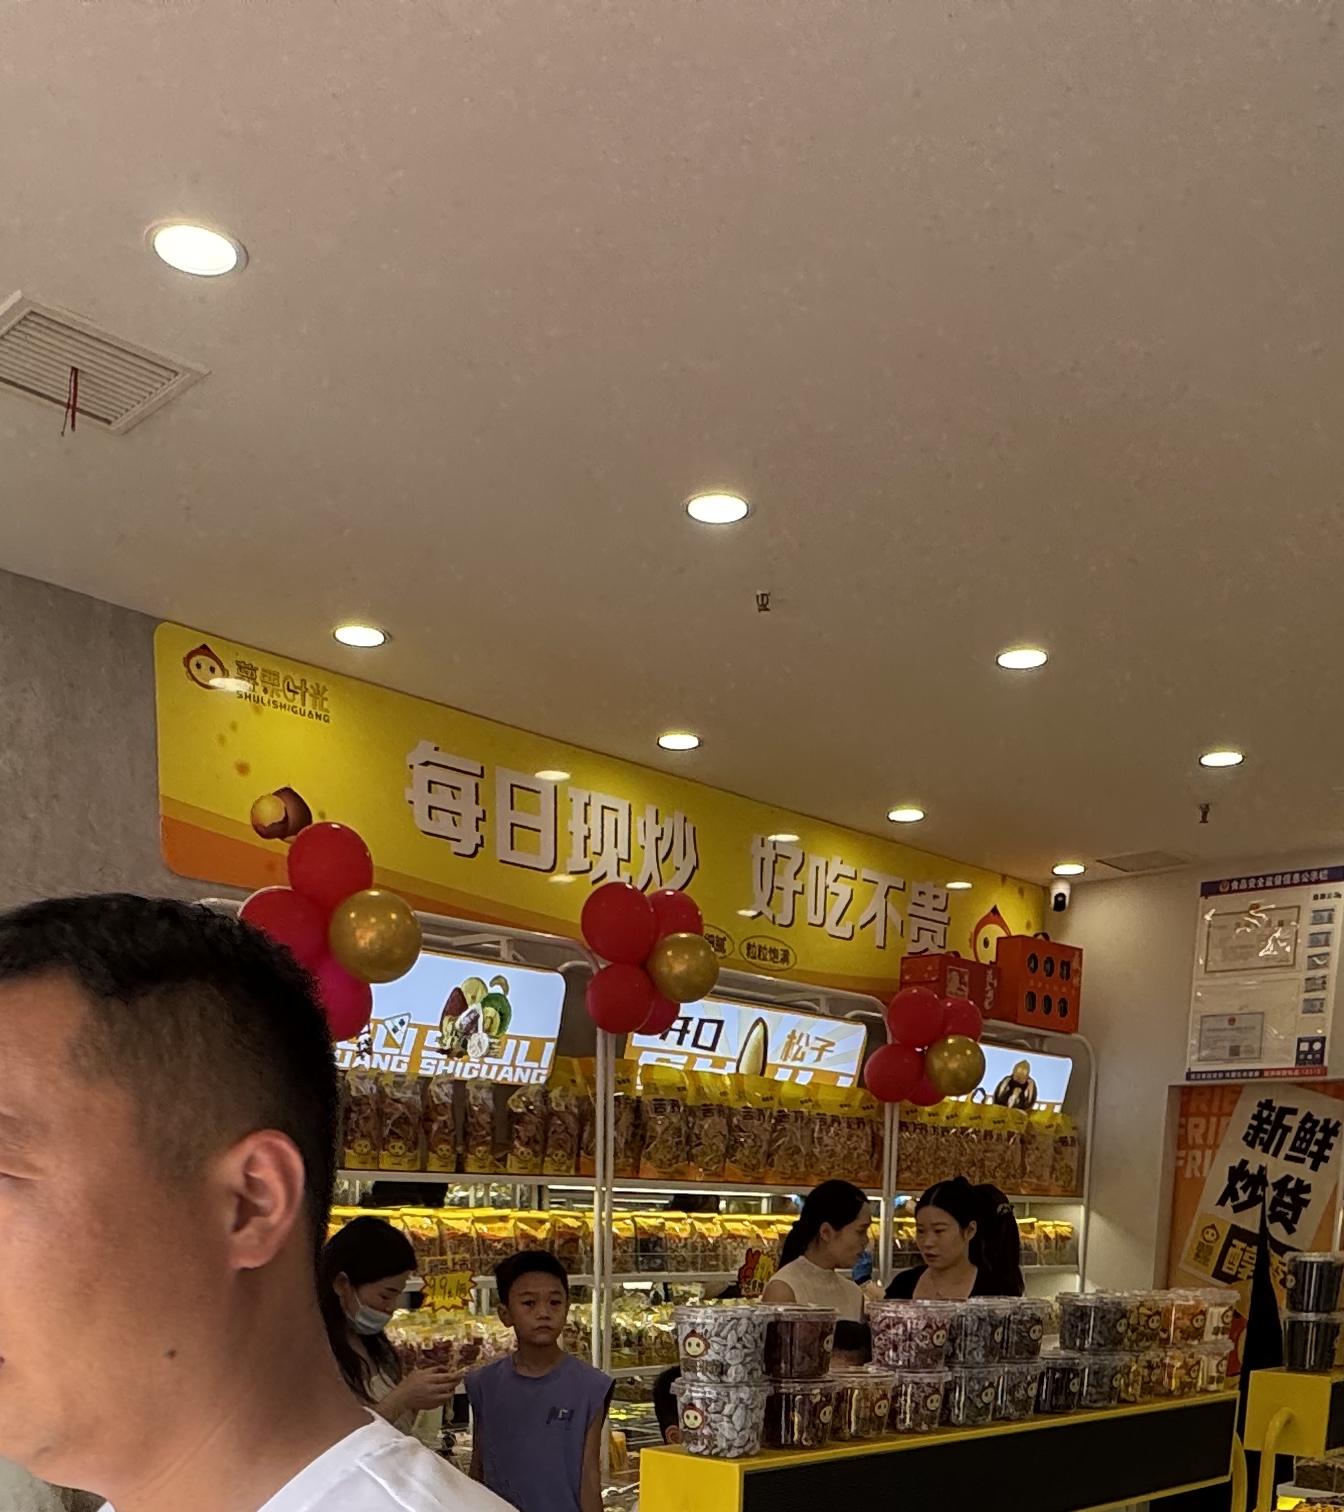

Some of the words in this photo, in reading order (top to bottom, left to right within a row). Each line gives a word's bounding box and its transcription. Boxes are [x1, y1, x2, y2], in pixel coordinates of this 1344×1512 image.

[236, 691, 331, 723] SHULISHIGUANG
[405, 740, 699, 893] 每日现炒
[751, 832, 952, 955] 好吃不贵
[418, 1058, 547, 1085] SHIGUANG
[780, 1029, 836, 1063] 松子
[1242, 1098, 1342, 1172] 新鲜
[1215, 1158, 1312, 1235] 炒货
